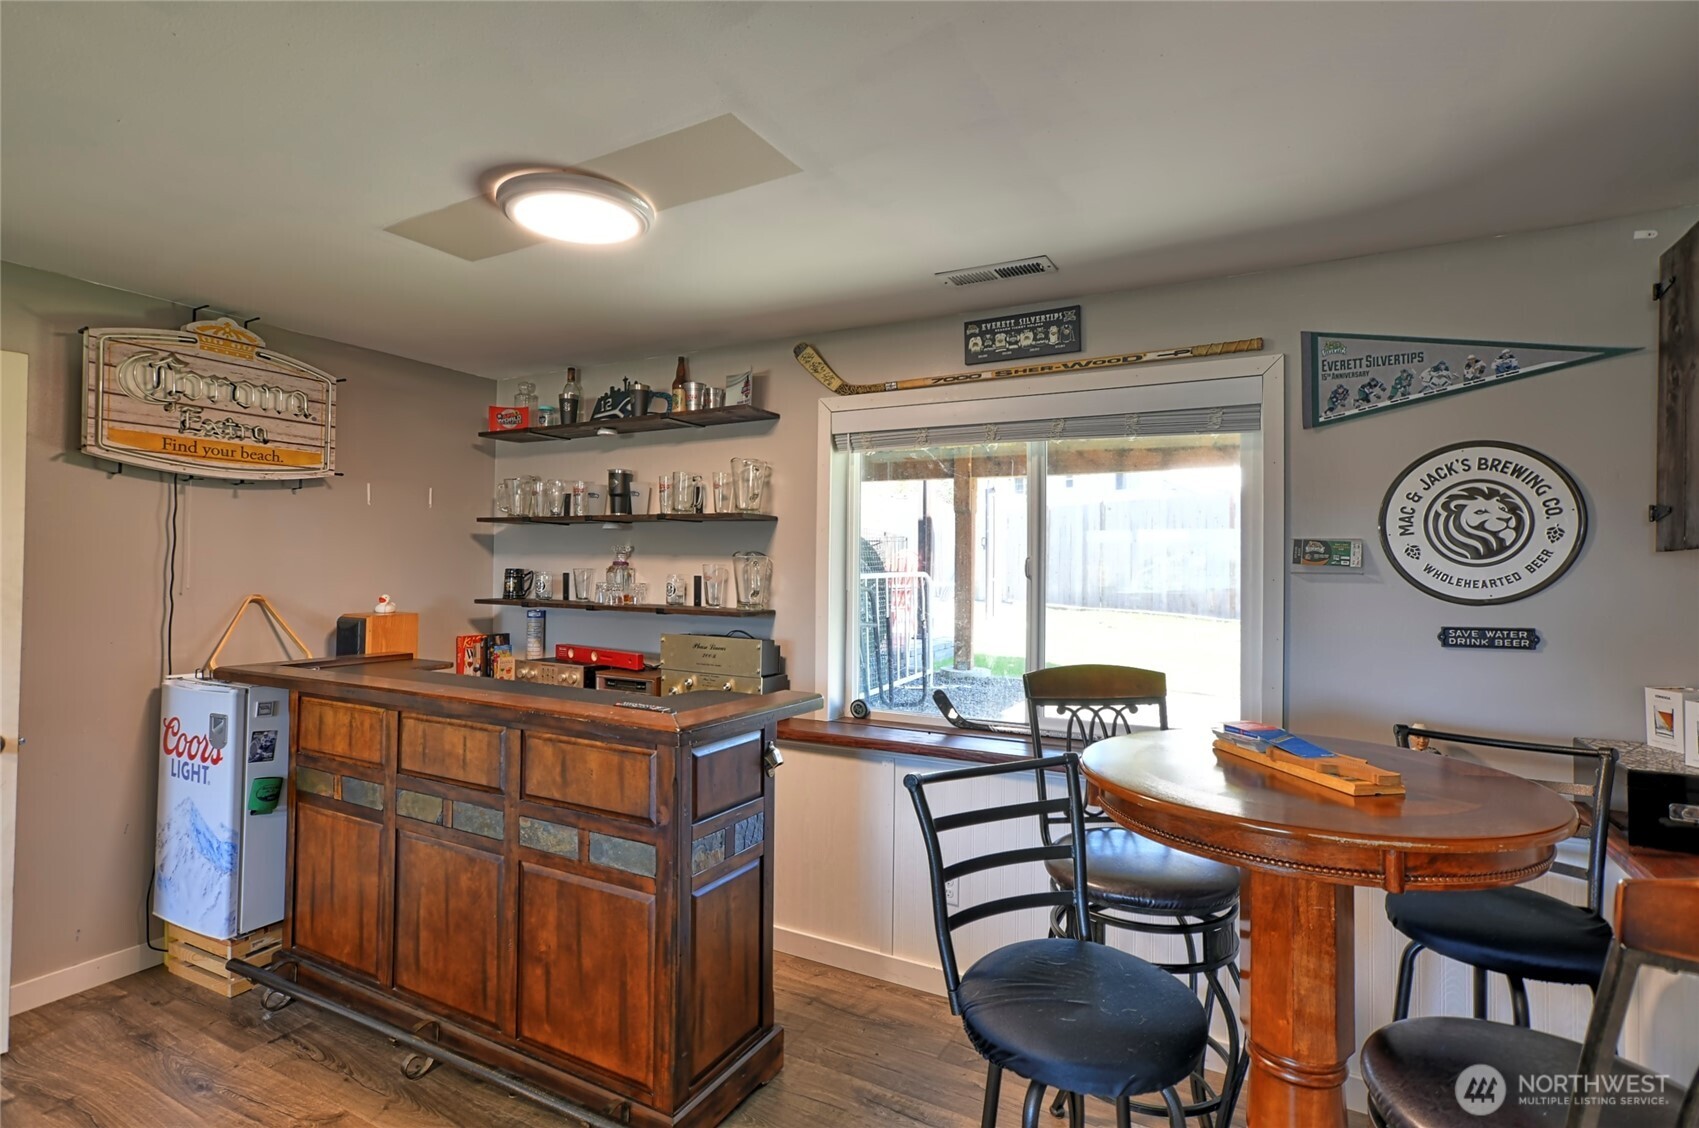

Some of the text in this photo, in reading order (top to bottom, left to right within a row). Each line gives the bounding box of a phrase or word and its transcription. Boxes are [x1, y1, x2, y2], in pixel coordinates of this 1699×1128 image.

[981, 319, 1015, 331] EVERETT
[1019, 312, 1063, 325] SILVERTIPS
[930, 373, 982, 385] 7000
[994, 354, 1143, 377] SHER-WOOD
[1321, 357, 1364, 373] EVERETT
[1365, 351, 1425, 368] SILVERTIPS
[1332, 370, 1370, 380] ANNIVERSARY
[116, 350, 313, 420] Corona
[600, 398, 612, 412] 12
[178, 405, 269, 444] Extra
[162, 437, 284, 463] Find your beach.
[1399, 457, 1564, 537] MAC & JACK'S BREWING CO.
[1422, 548, 1554, 590] WHOLEHEARTED BEER
[1448, 630, 1528, 639] SAVE WATER
[1448, 637, 1530, 648] DRINK BEER
[171, 758, 210, 785] LIGHT
